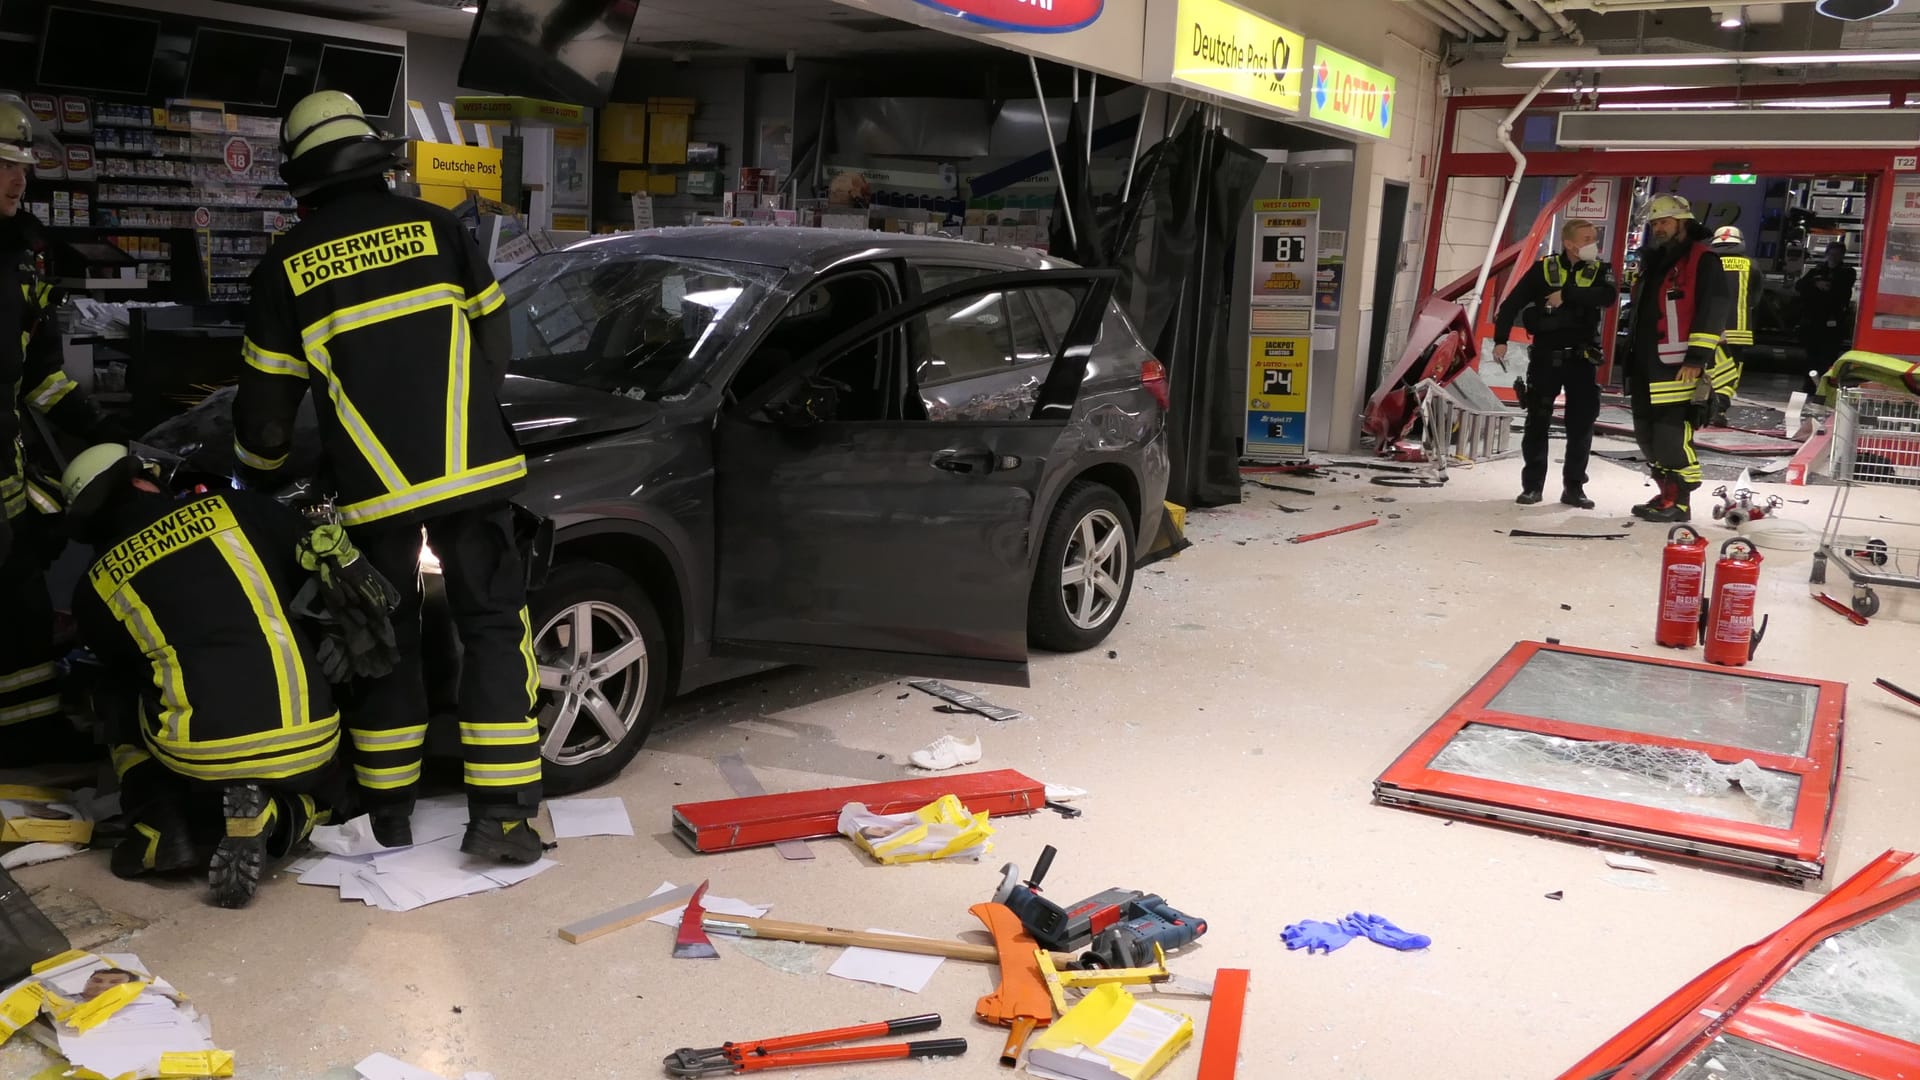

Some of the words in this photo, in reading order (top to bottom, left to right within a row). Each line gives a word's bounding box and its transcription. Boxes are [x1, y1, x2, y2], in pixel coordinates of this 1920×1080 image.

[1192, 22, 1244, 69] Deutsche
[1247, 43, 1268, 81] Post
[1333, 70, 1376, 122] LOTTO
[231, 154, 246, 168] 18
[432, 157, 475, 173] Deutsche
[477, 161, 496, 175] Post
[1896, 158, 1916, 167] T22
[289, 224, 428, 274] FEUERWEHR
[1276, 237, 1305, 261] 87
[301, 240, 425, 288] DORTMUND
[1265, 341, 1295, 349] JACKPOT
[1264, 370, 1292, 393] 24
[1275, 424, 1283, 437] 3
[91, 497, 223, 581] FEUERWEHR
[109, 516, 216, 585] DORTMUND
